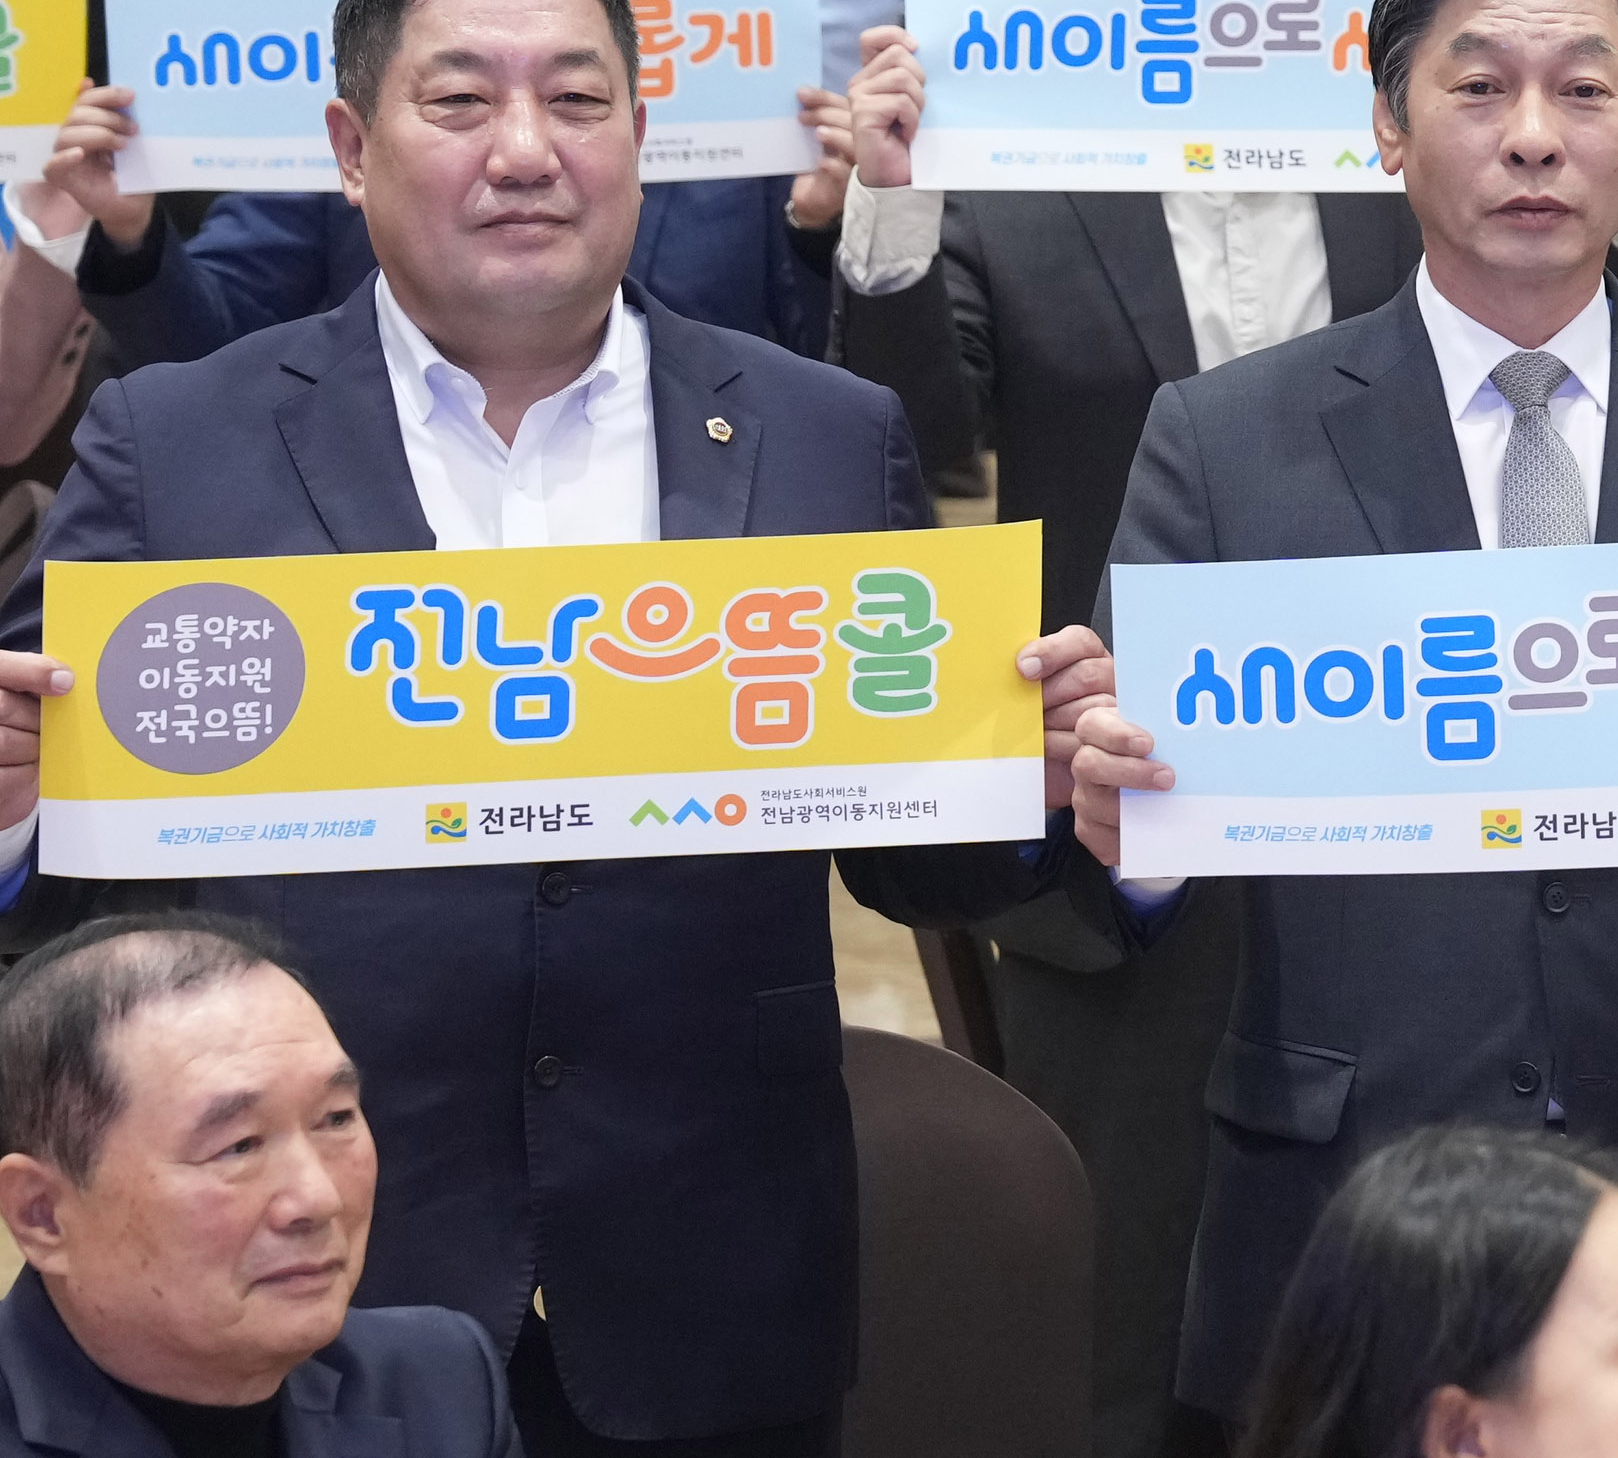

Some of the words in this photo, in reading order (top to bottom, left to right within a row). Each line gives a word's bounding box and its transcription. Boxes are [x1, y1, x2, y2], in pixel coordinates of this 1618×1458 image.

[1223, 147, 1307, 170] 전라남도
[140, 613, 275, 653] 교통약자
[348, 572, 949, 746] 전남으뜸콜
[138, 657, 273, 700] 이동지원
[135, 702, 274, 745] 전국으뜸!
[760, 784, 868, 802] 전라남도사회서비스원
[479, 801, 595, 836] 전라남도
[760, 798, 939, 827] 전남광역이동지원센터
[156, 822, 257, 847] 복권기금으로
[258, 820, 309, 842] 사회적
[310, 817, 378, 840] 가치창출
[1223, 824, 1318, 844] 복권기금으로
[1319, 823, 1370, 843] 사회적
[1371, 822, 1434, 842] 가치창출
